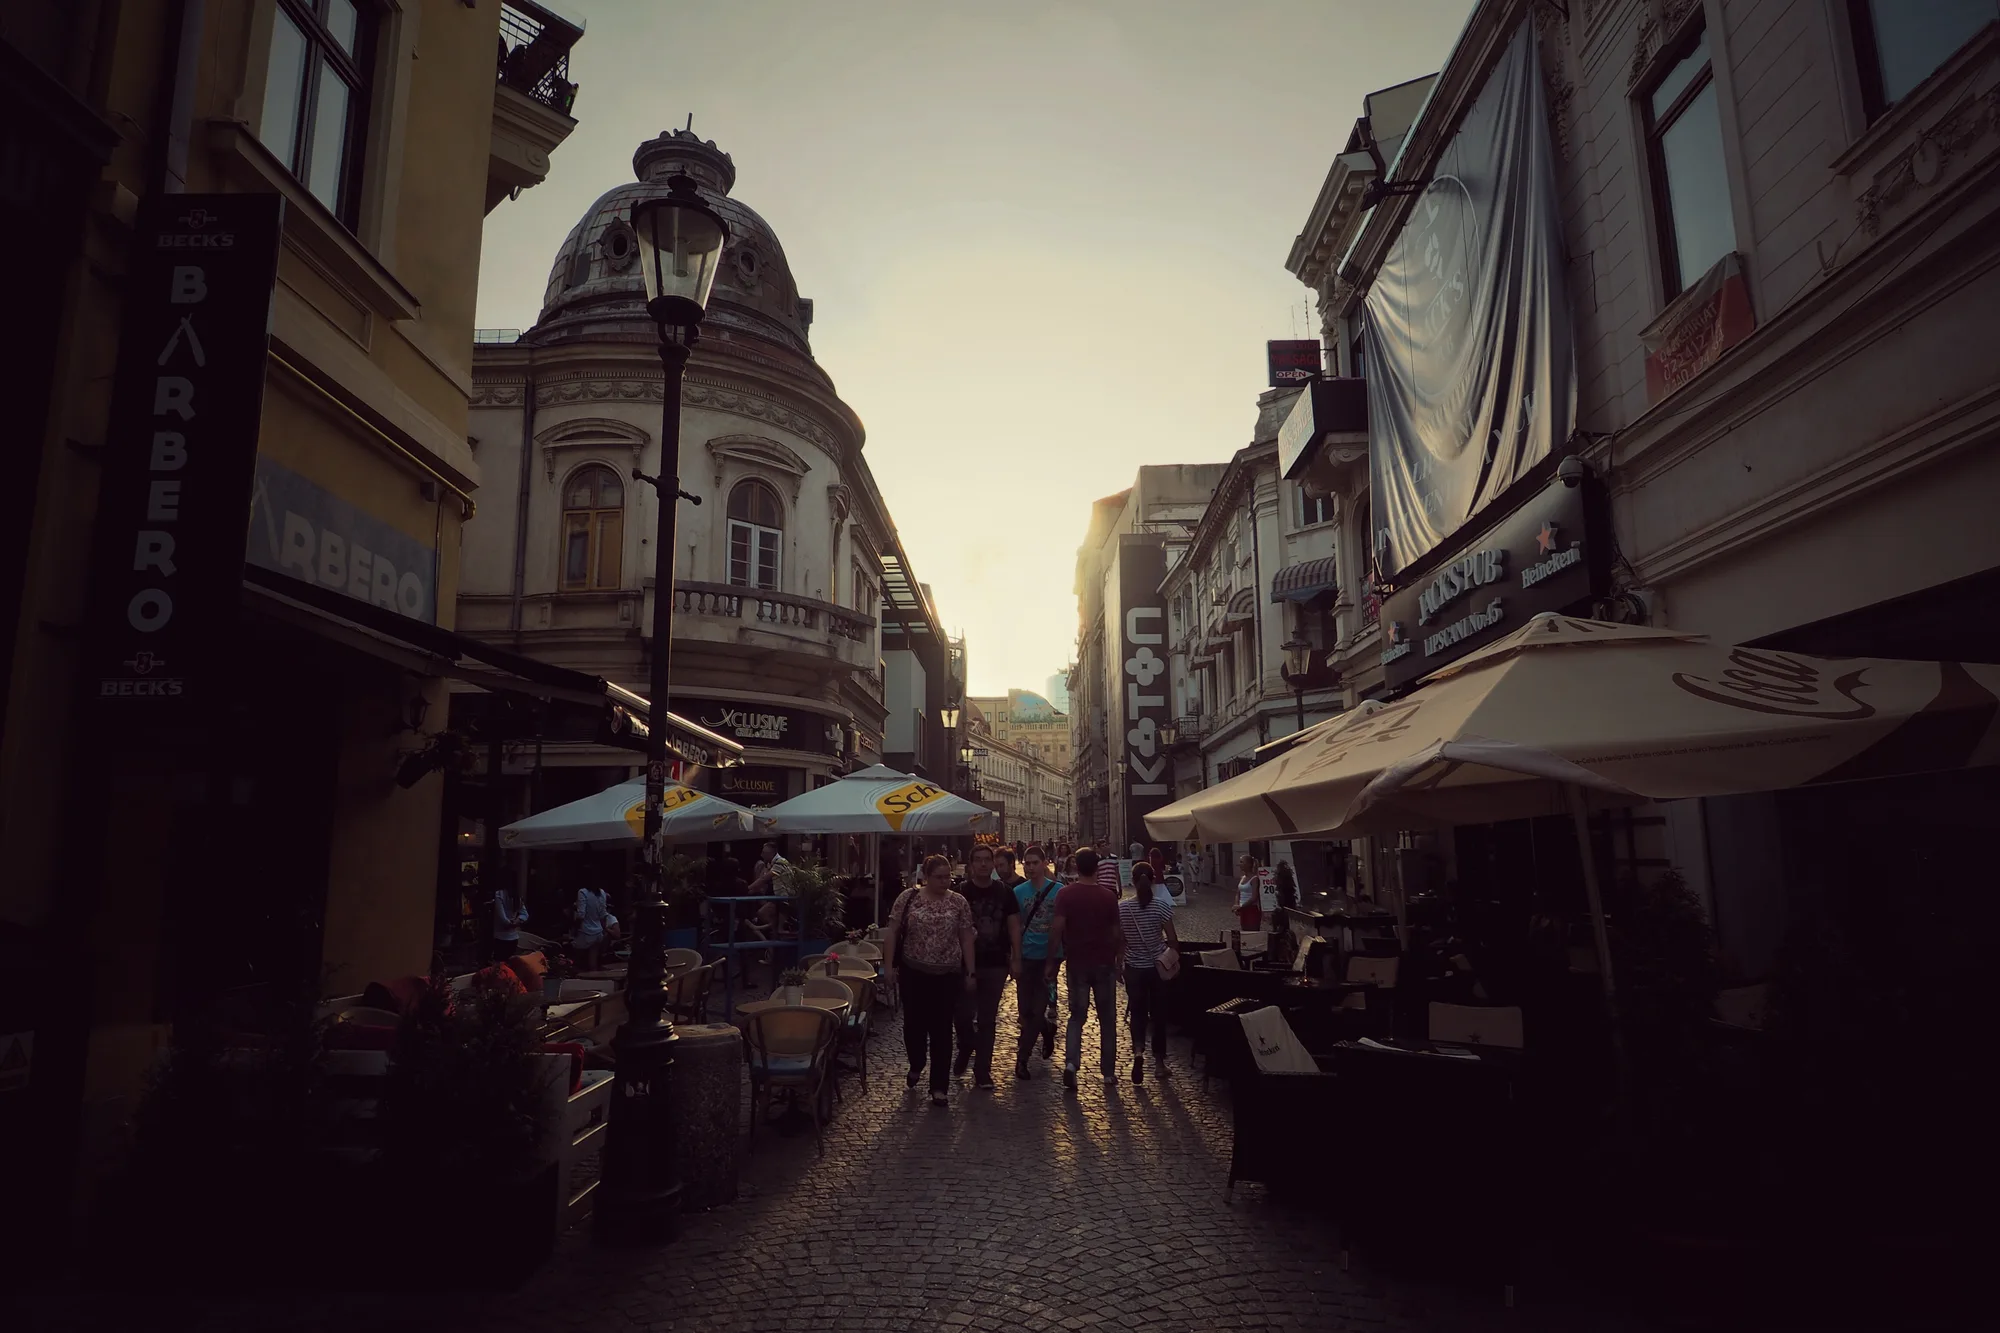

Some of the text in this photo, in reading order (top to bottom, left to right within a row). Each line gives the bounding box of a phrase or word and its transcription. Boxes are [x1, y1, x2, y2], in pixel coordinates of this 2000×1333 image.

[156, 232, 235, 248] BECK'S
[127, 265, 208, 633] BARBERO
[249, 477, 425, 620] ARBERO
[1463, 550, 1503, 591] PUB
[1521, 547, 1582, 589] Heineken
[101, 679, 184, 697] BECK'S
[1125, 606, 1168, 796] KOTON
[700, 708, 788, 732] XCLUSIVE
[668, 734, 709, 765] ARBERO
[723, 777, 776, 791] XCLUSIVE
[883, 784, 939, 814] Sch
